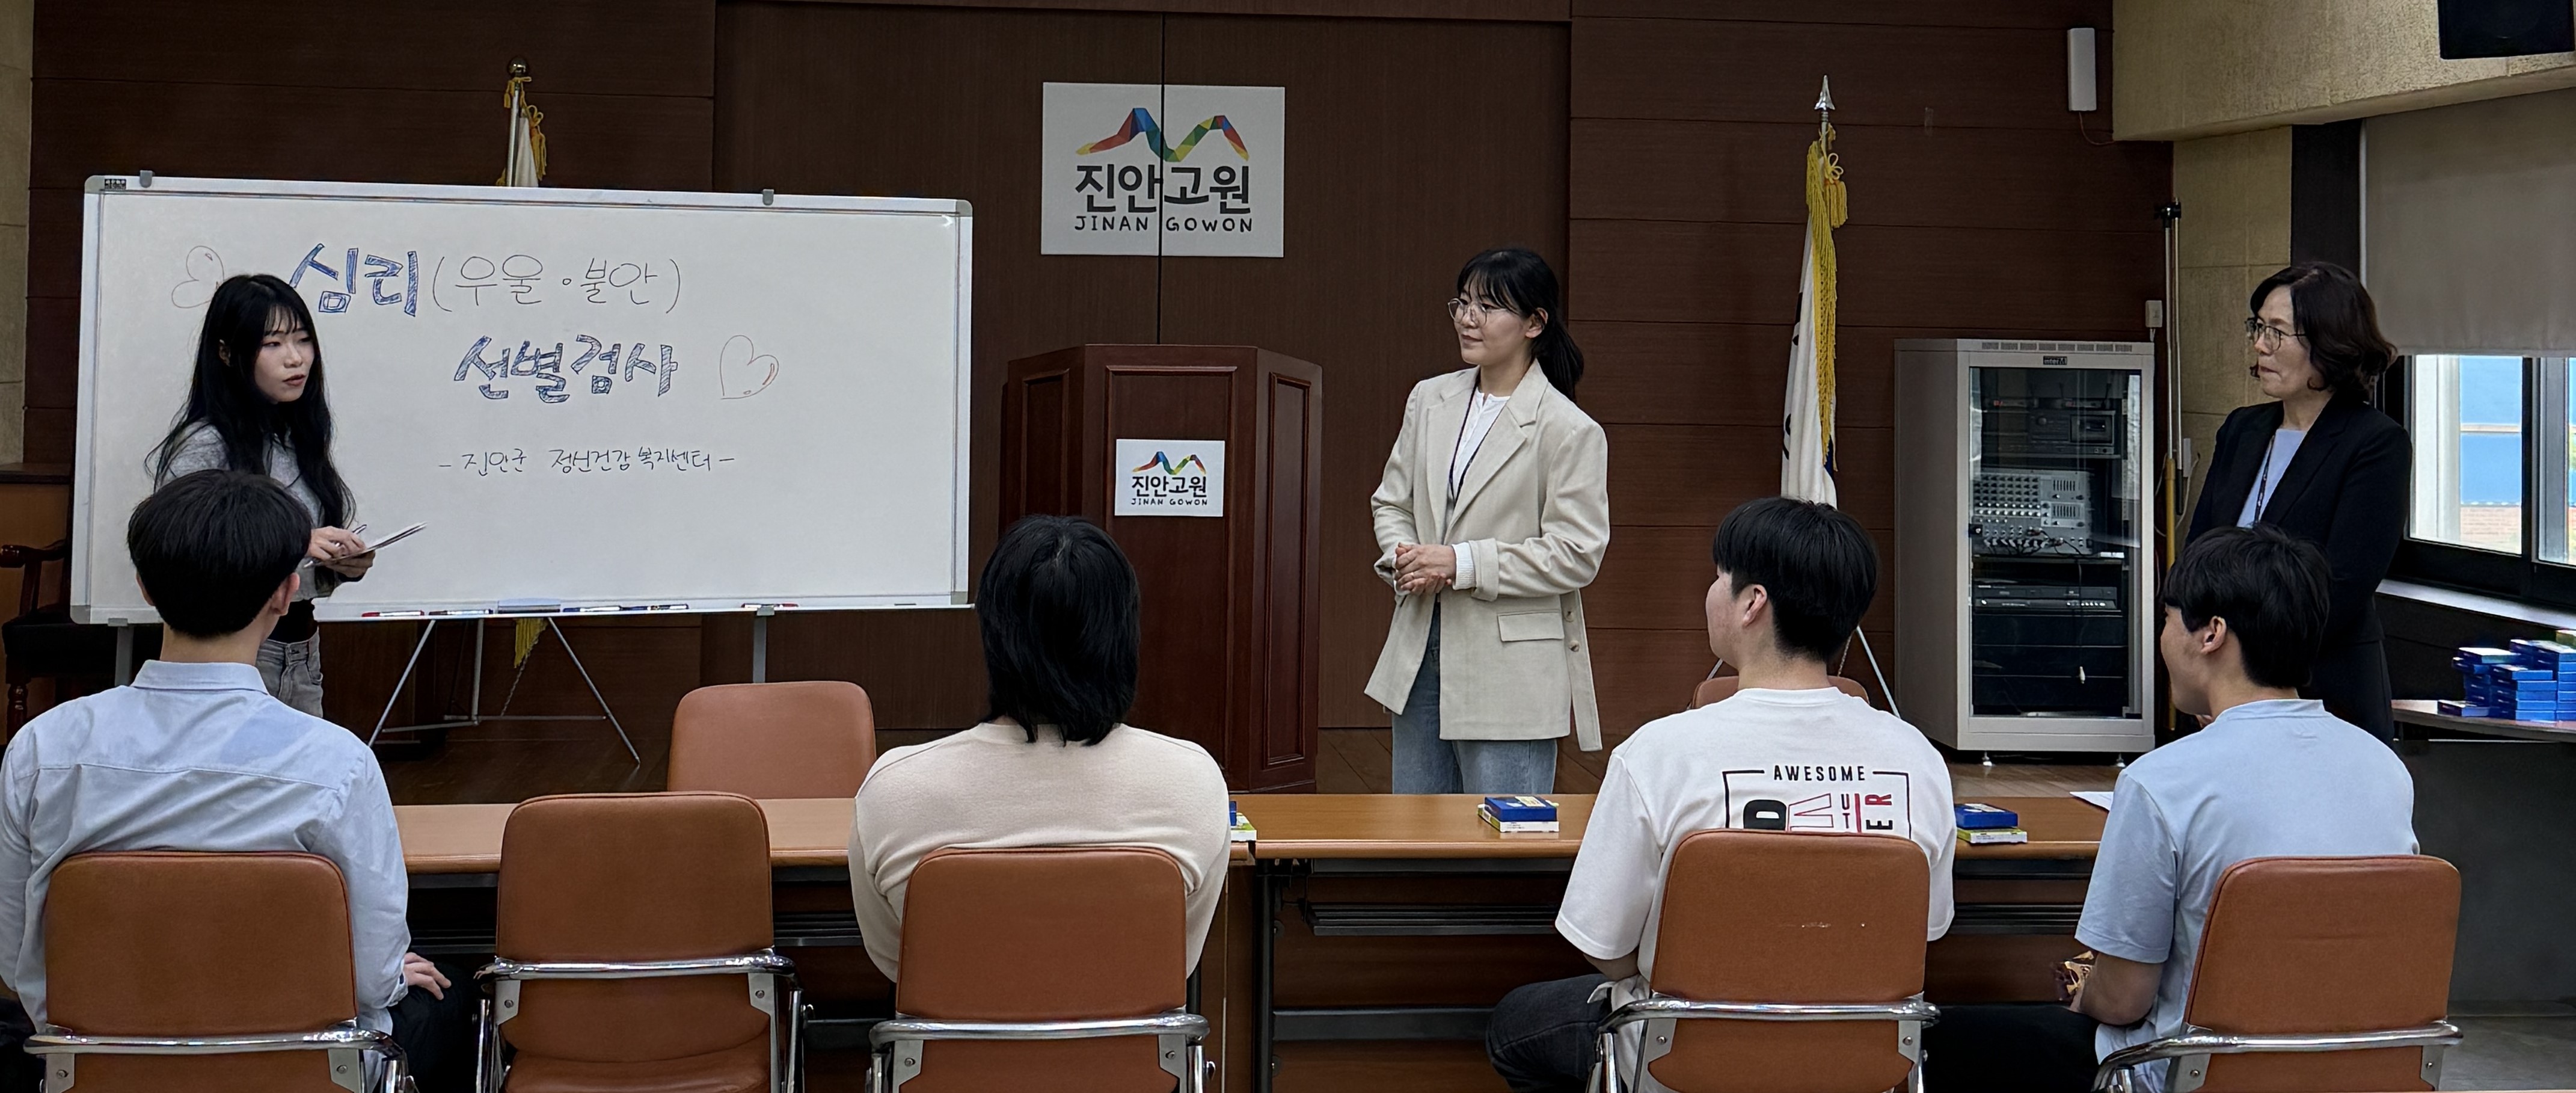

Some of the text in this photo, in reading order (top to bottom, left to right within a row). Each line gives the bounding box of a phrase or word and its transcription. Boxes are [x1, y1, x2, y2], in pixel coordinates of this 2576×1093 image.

[1075, 164, 1251, 214] 진안고원
[1075, 215, 1252, 232] JINAN GOWON
[454, 334, 678, 404] 선별검사
[1132, 476, 1207, 497] 진안고원
[1774, 765, 1865, 781] AWESOME
